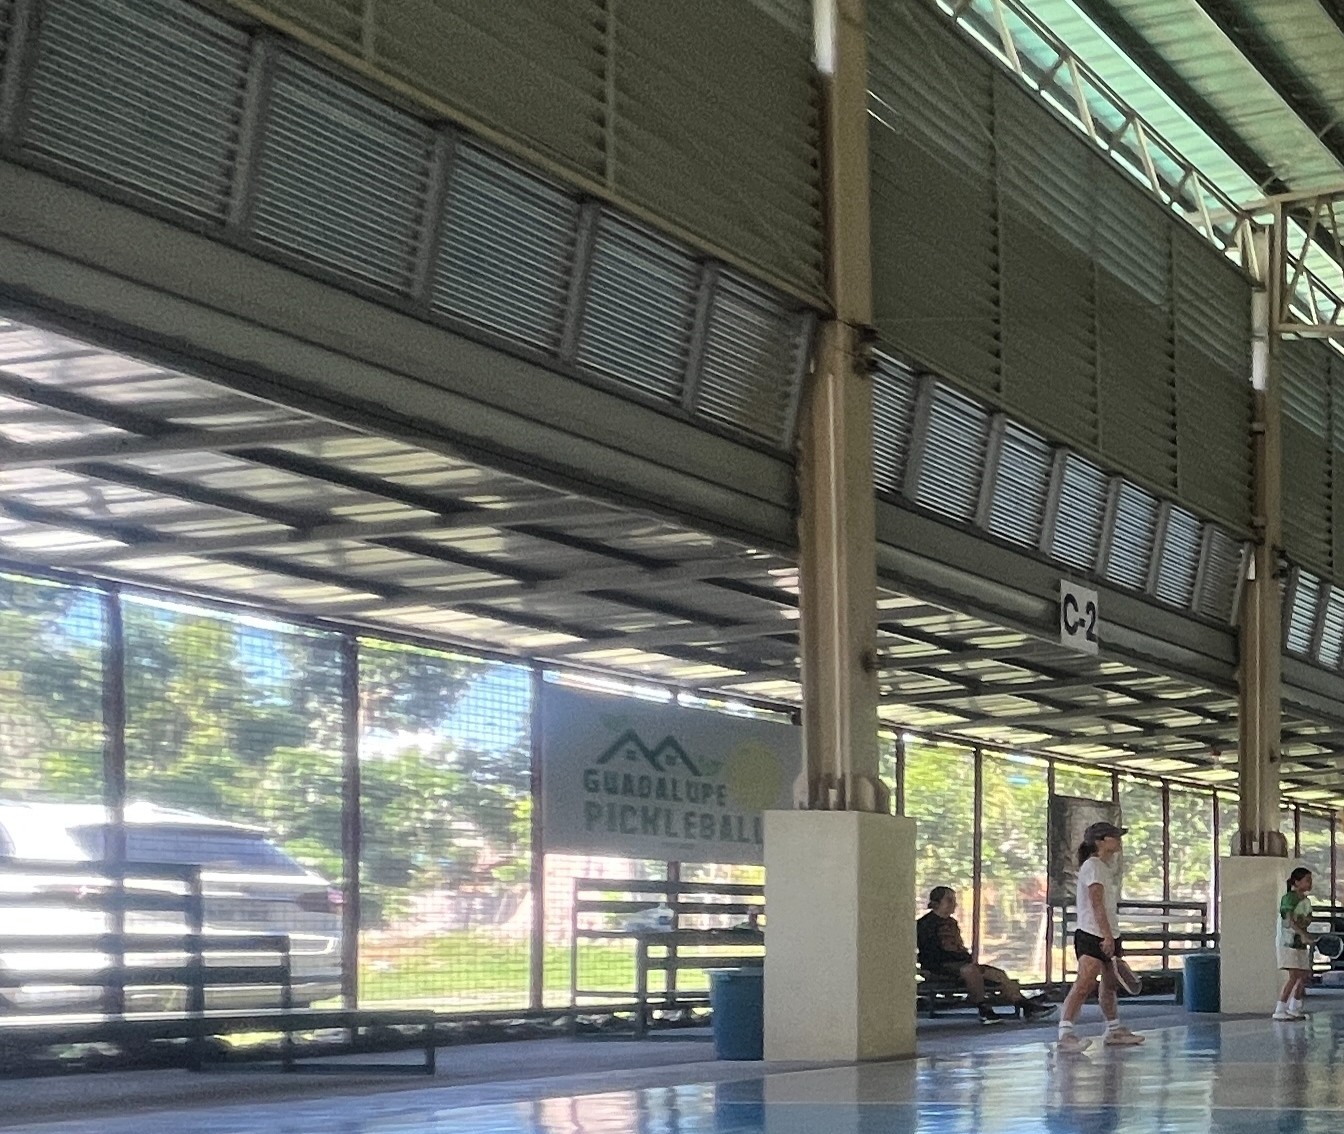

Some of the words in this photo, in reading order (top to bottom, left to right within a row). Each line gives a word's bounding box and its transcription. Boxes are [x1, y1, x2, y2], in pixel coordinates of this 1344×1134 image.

[1064, 594, 1097, 642] C-2
[583, 768, 728, 806] GUADALUPE
[584, 801, 763, 845] PICKLEBALL
